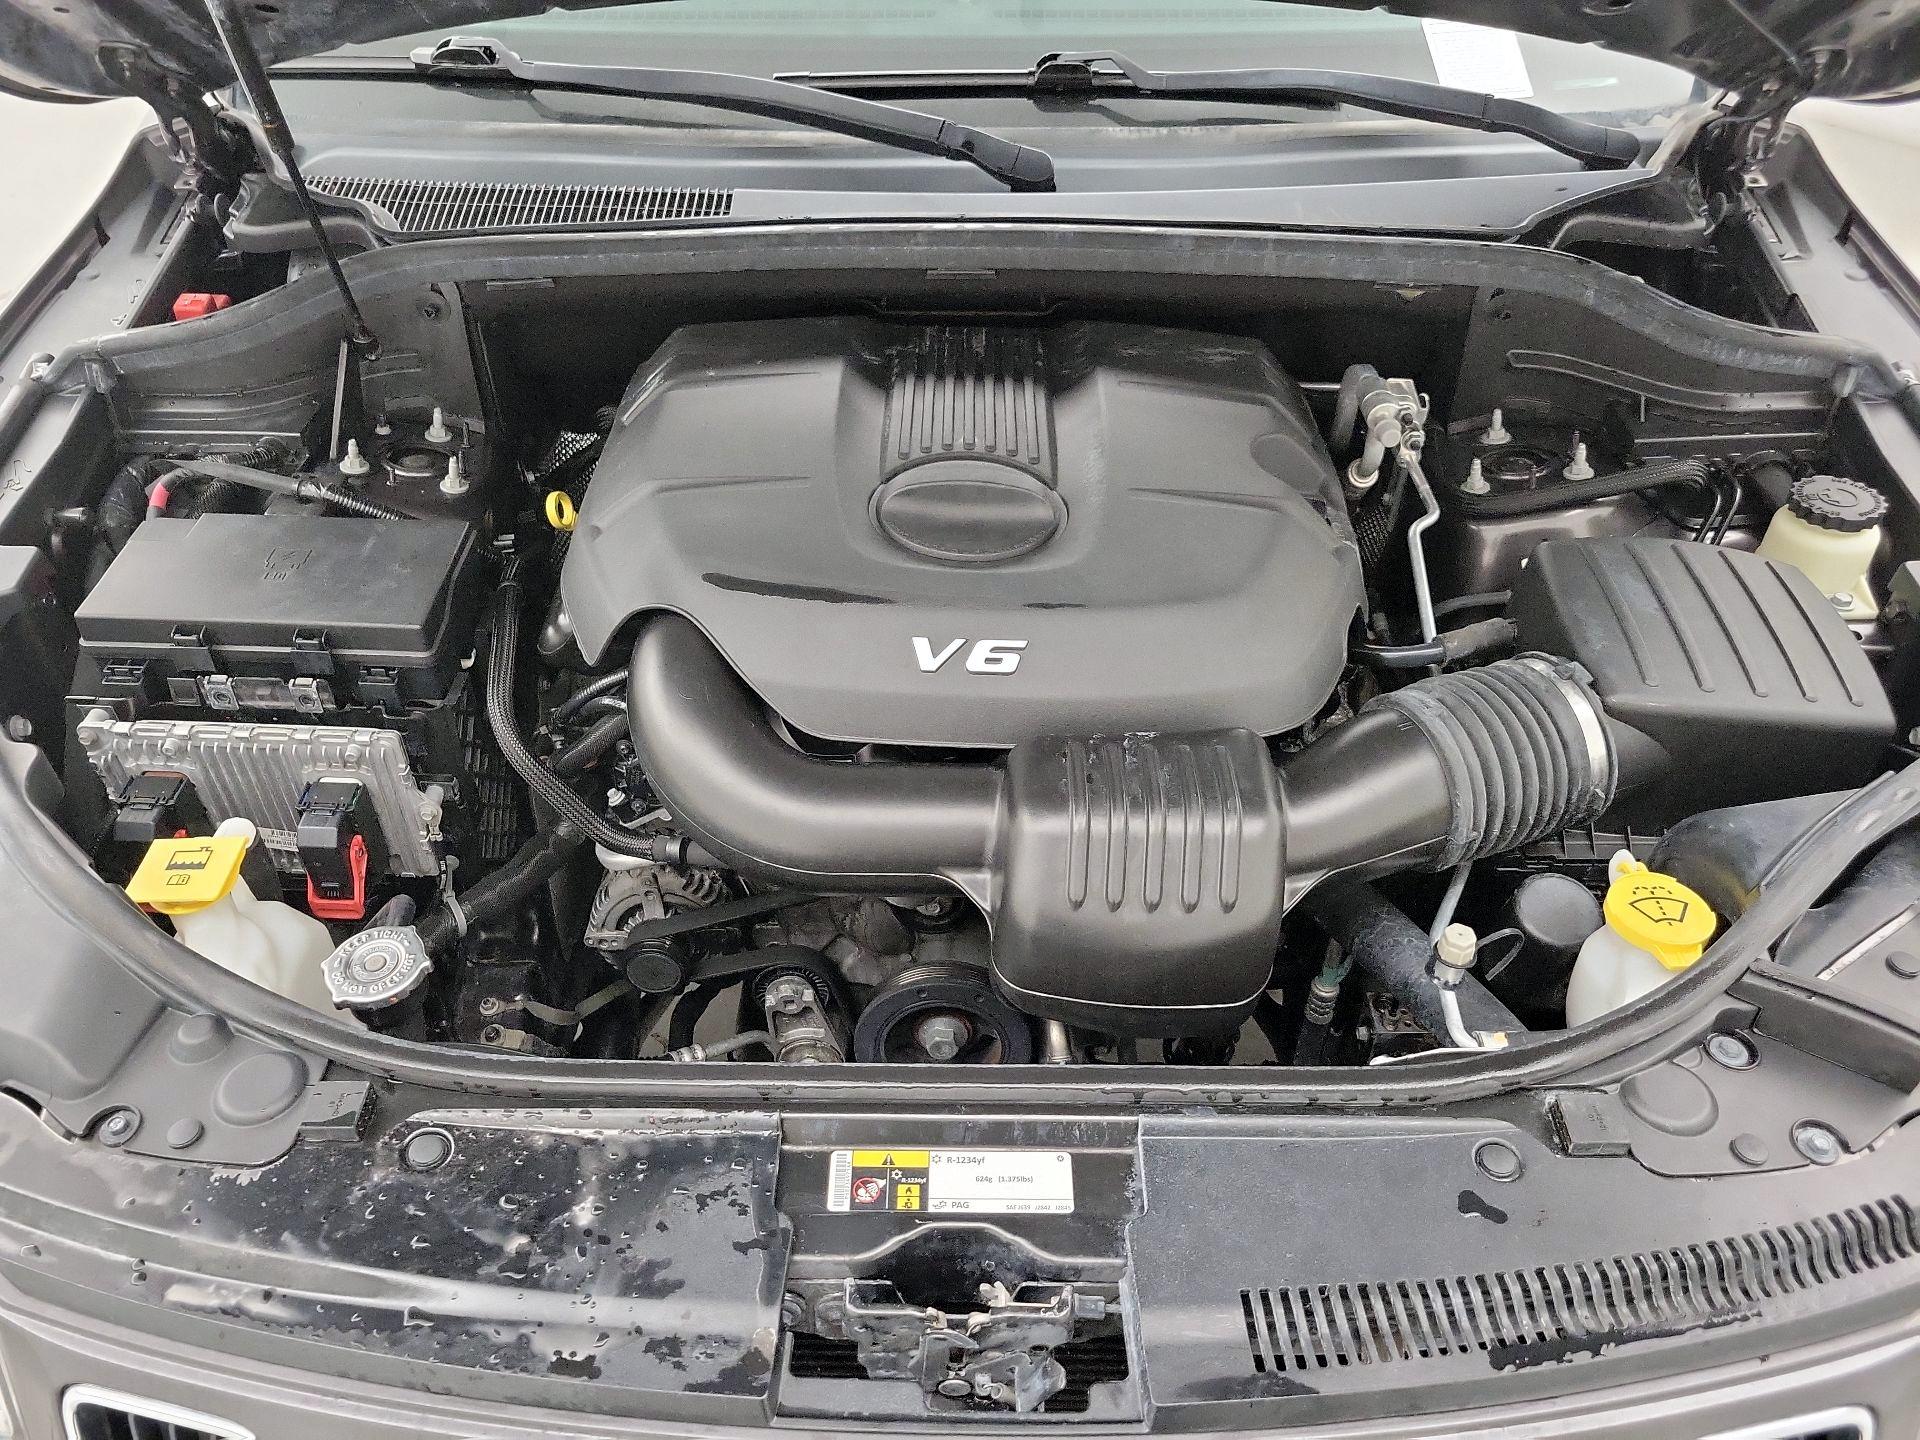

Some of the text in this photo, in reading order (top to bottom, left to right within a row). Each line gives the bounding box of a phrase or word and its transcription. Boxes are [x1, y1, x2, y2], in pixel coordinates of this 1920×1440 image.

[911, 636, 1030, 676] V6
[340, 930, 407, 956] KEEP TIGHT
[342, 982, 367, 993] NOT
[370, 973, 404, 993] OPEN
[401, 953, 417, 973] HOT
[946, 1156, 985, 1166] R-1234yf
[975, 1175, 1034, 1184] 624g (1.375lbs)
[951, 1201, 970, 1209] PAG
